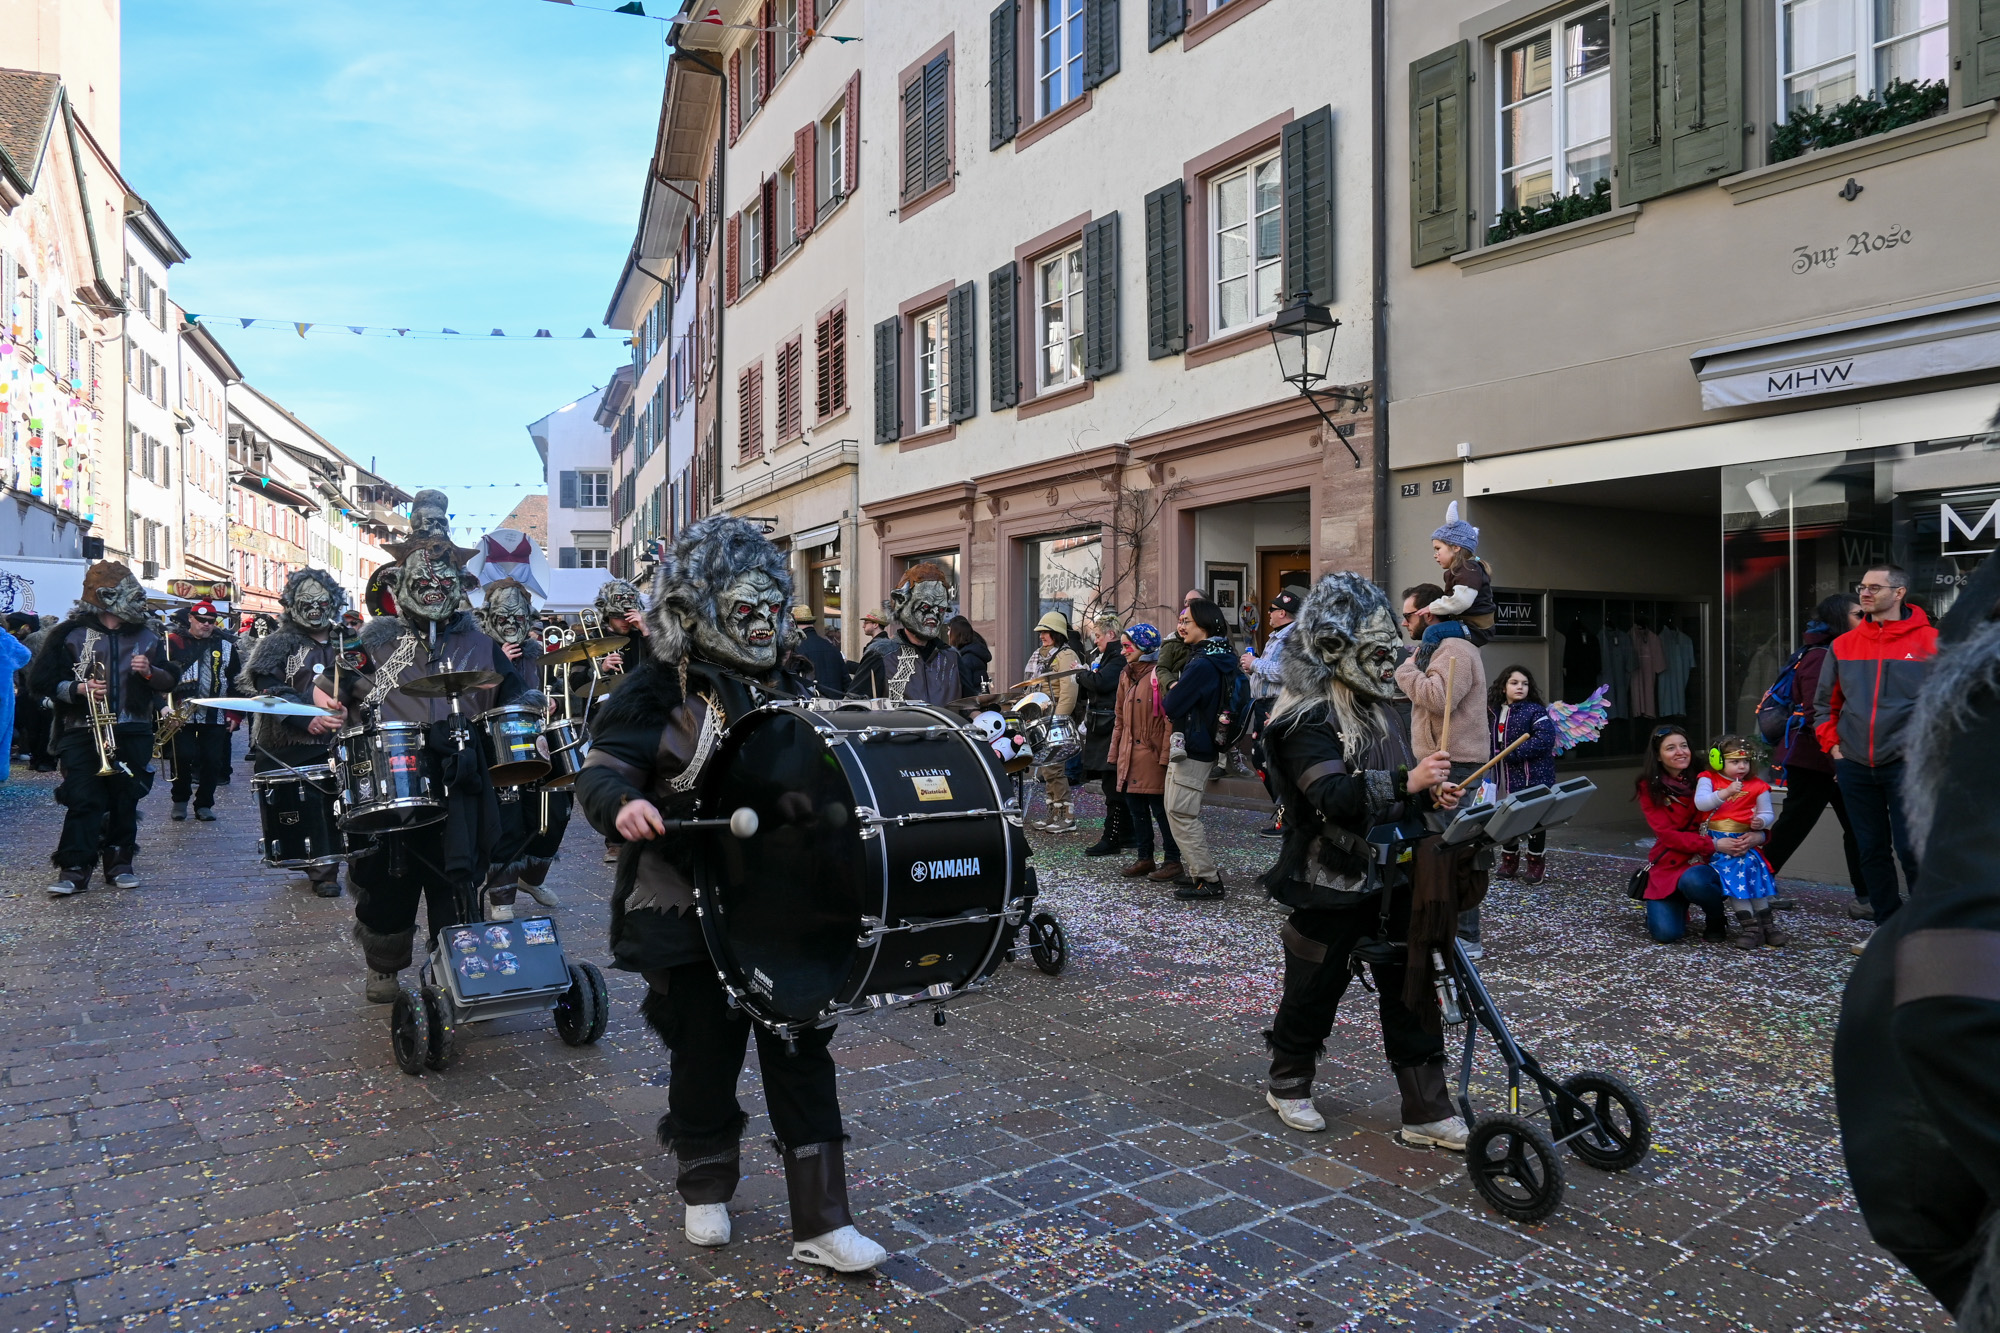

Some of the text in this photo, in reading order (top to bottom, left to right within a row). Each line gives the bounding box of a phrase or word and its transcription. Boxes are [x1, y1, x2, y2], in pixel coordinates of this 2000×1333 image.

[1792, 223, 1913, 275] Zur Rose
[1767, 362, 1854, 393] MHW
[1340, 425, 1351, 435] 23
[1403, 484, 1416, 495] 25
[1435, 480, 1447, 492] 27
[1941, 498, 2000, 543] M
[1935, 574, 1968, 586] 50%
[1497, 605, 1532, 619] MHW
[928, 857, 981, 880] YAMAHA
